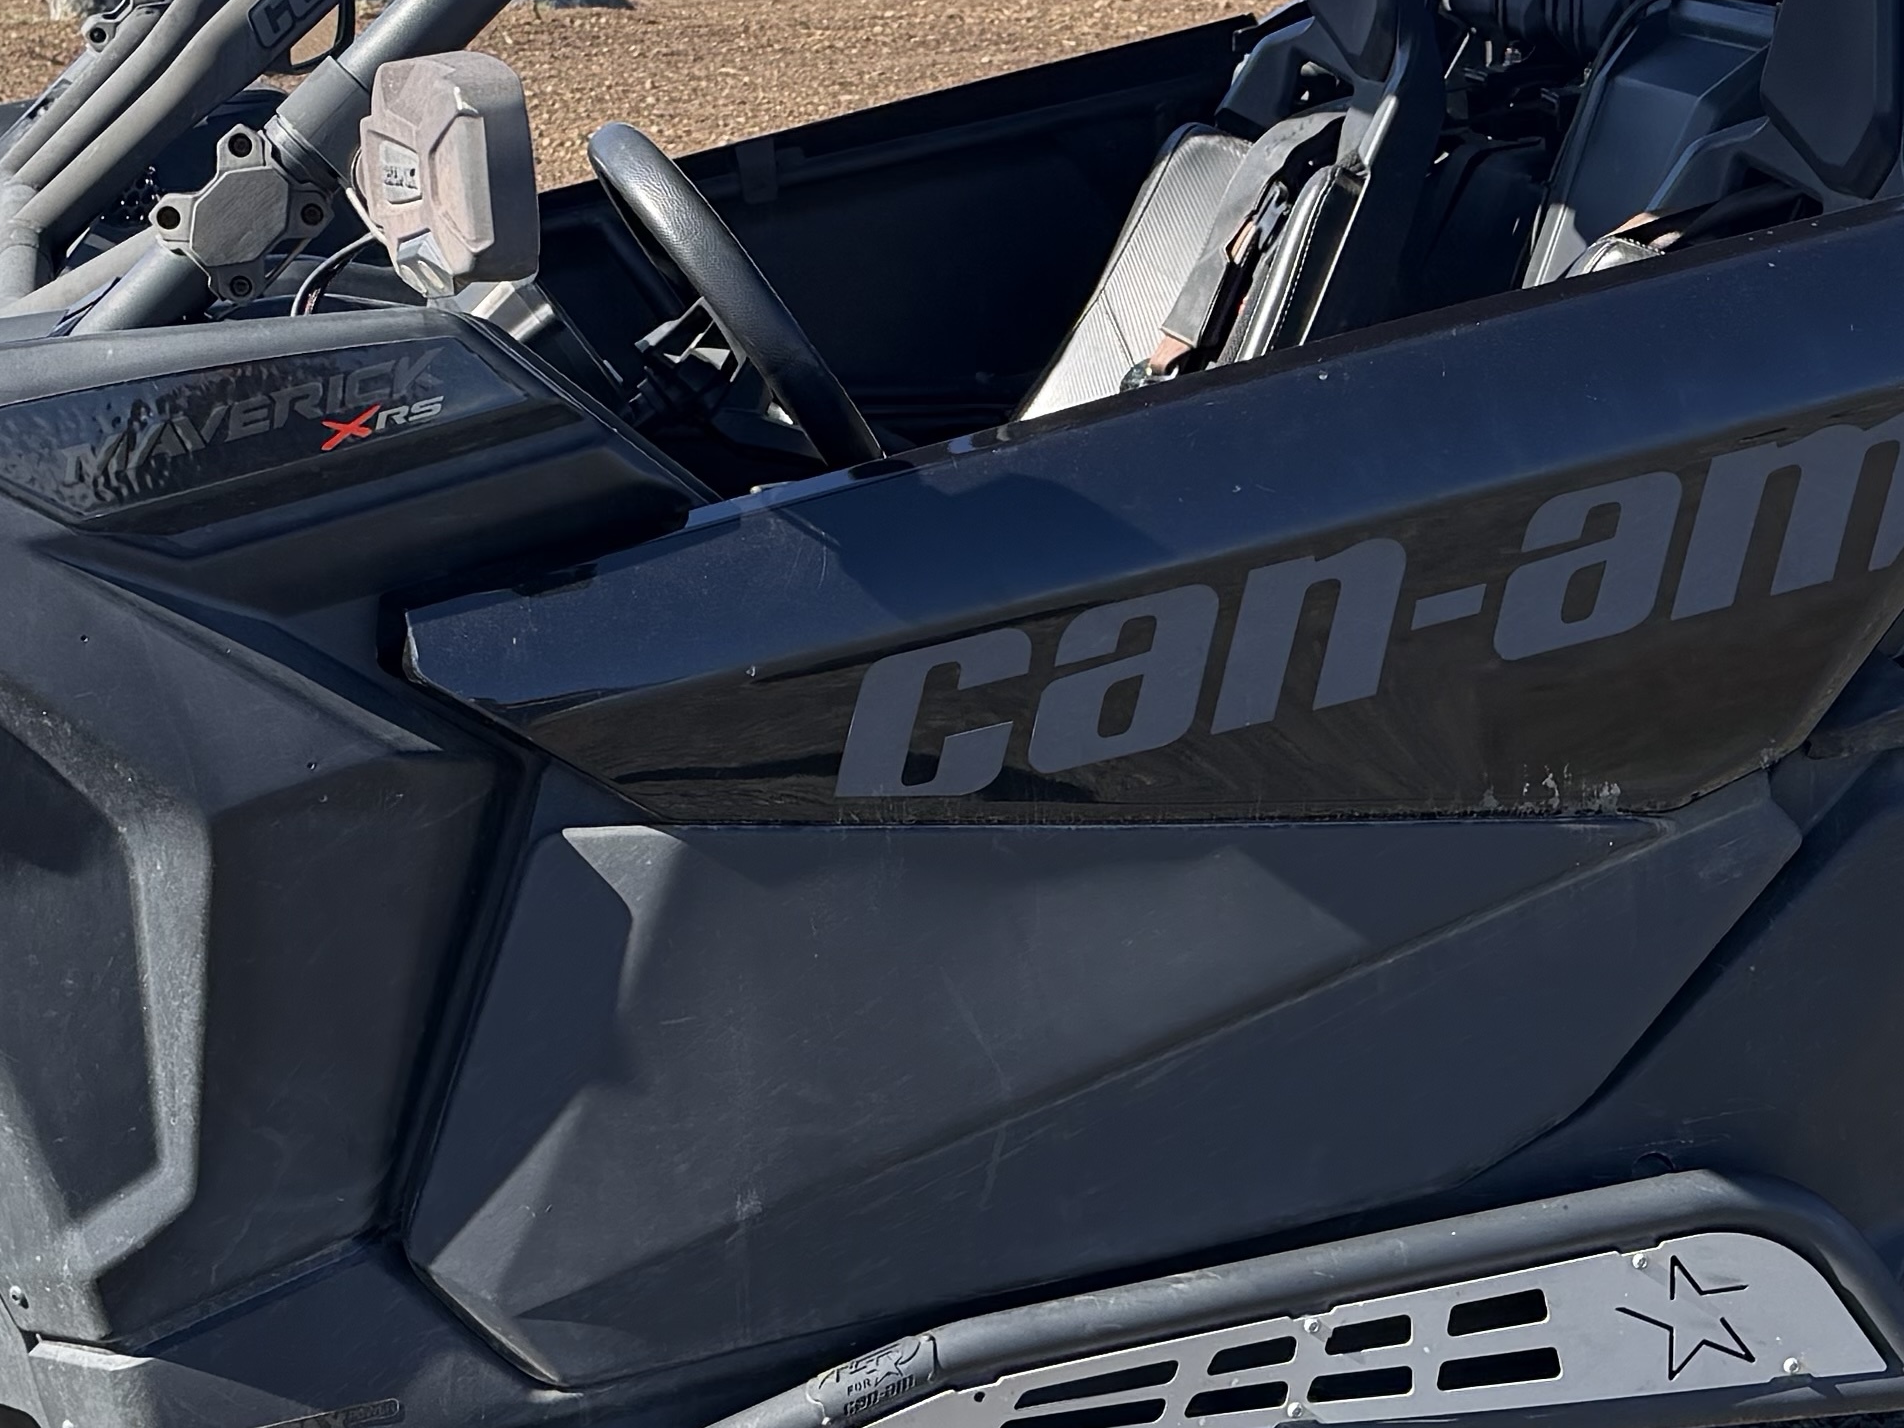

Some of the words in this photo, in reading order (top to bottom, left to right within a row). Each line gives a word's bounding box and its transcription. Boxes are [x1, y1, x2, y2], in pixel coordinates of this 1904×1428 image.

[63, 346, 445, 487] MAVERICK
[843, 1373, 916, 1417] can-am
[847, 1377, 872, 1396] FOR
